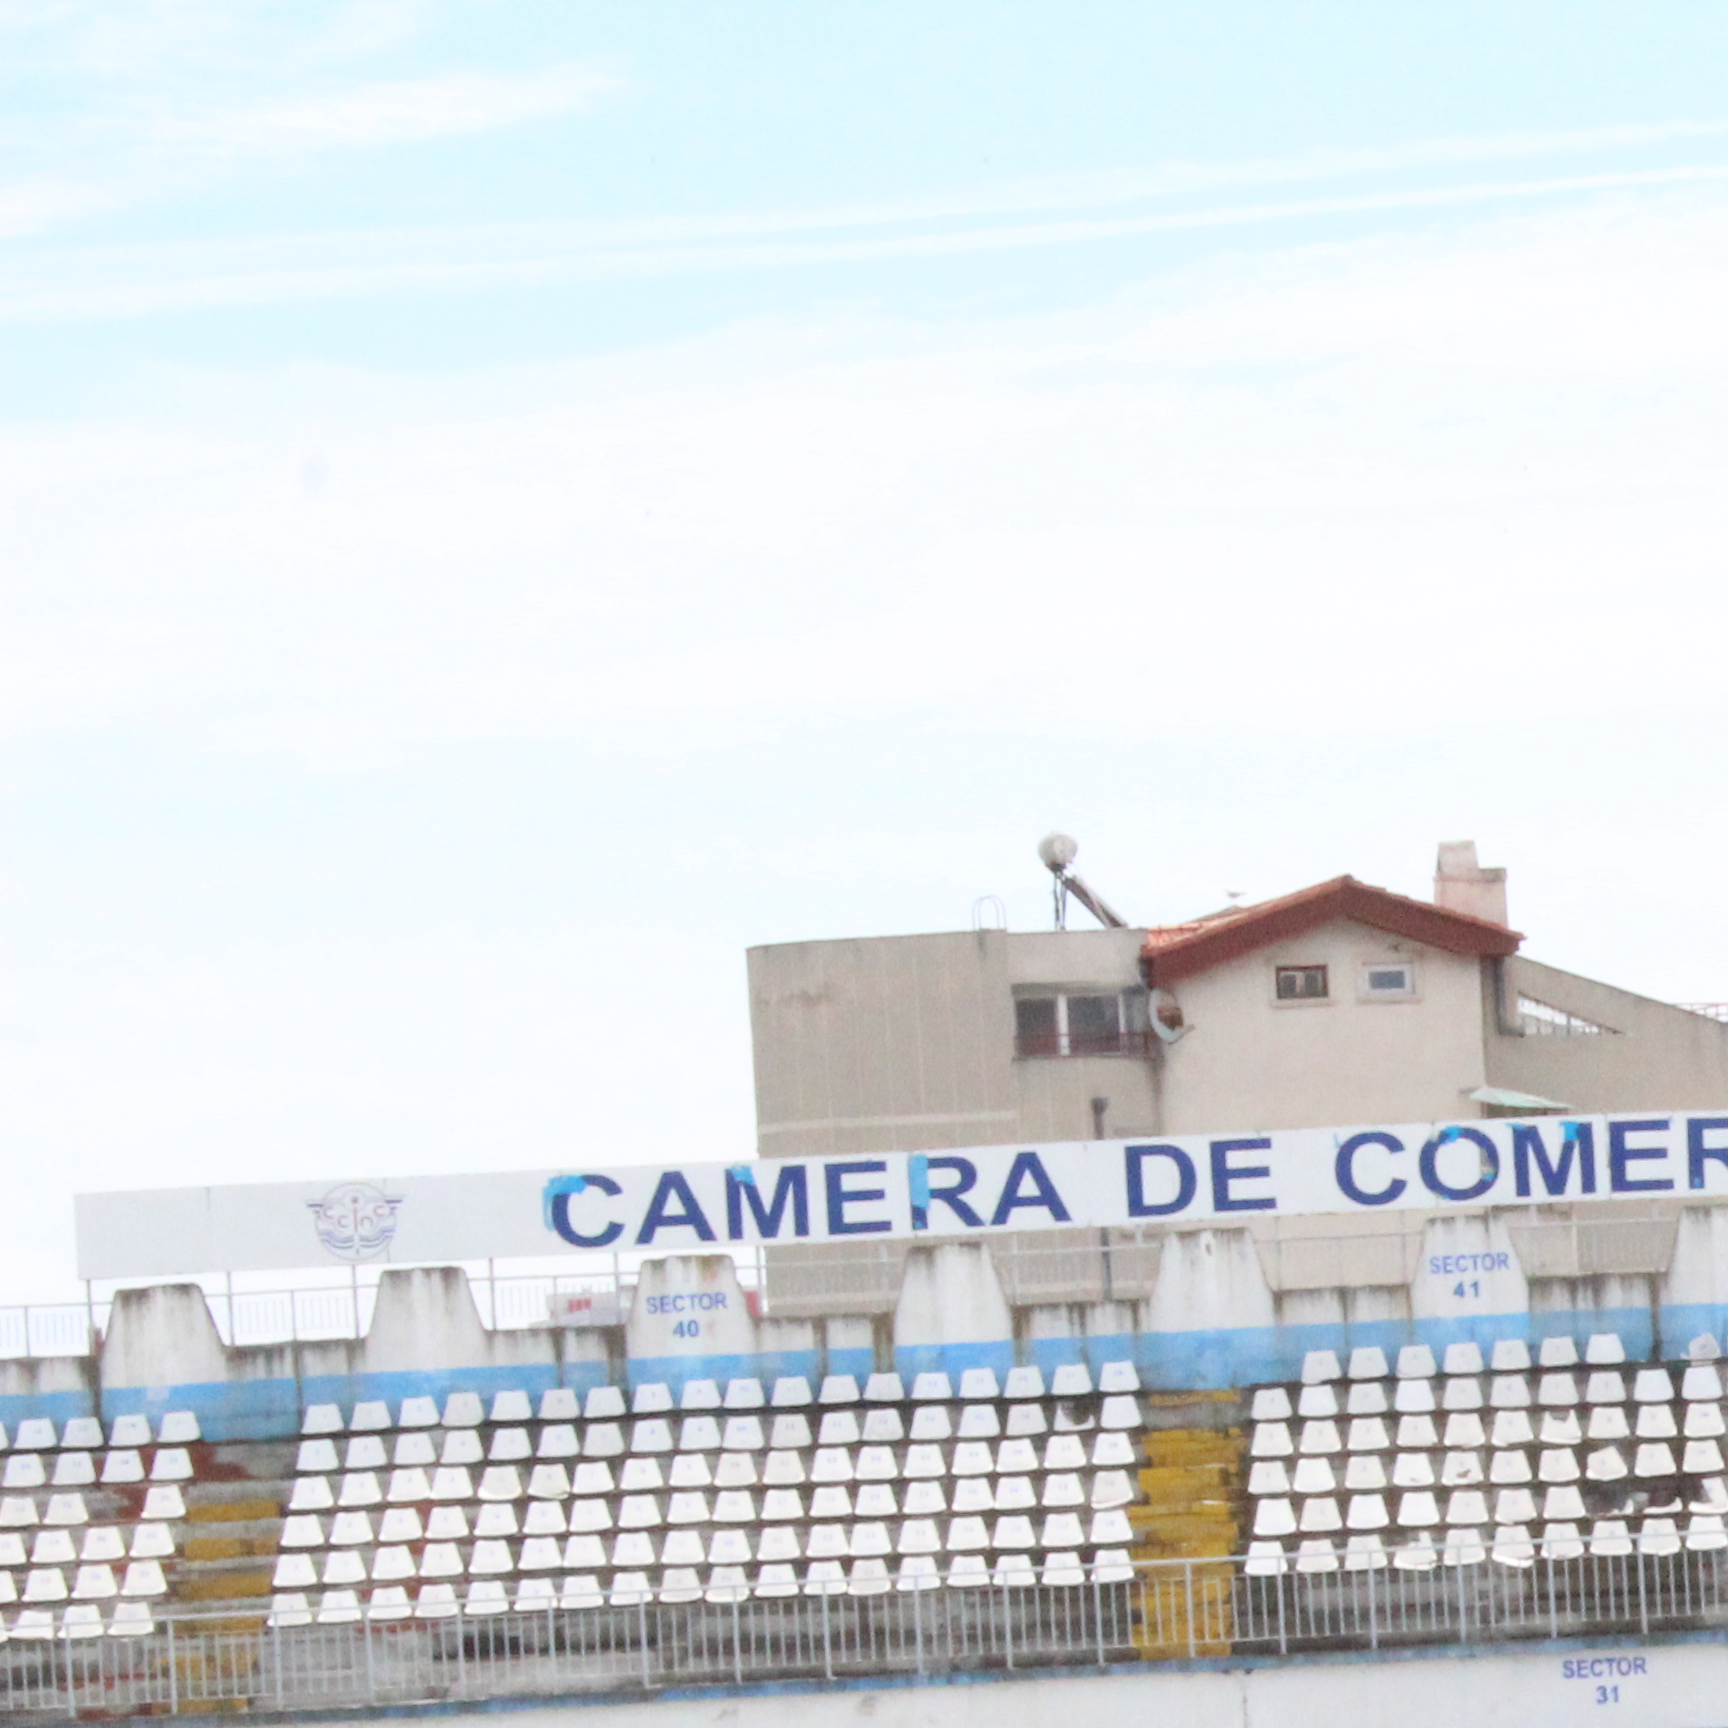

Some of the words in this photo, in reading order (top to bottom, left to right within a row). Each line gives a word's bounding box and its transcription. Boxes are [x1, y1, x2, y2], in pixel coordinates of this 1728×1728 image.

[550, 1151, 1070, 1247] CAMERA
[1126, 1138, 1275, 1218] DE
[1429, 1251, 1510, 1275] SECTOR
[1452, 1280, 1480, 1298] 41
[646, 1292, 728, 1315] SECTOR
[672, 1319, 700, 1338] 40
[1562, 1656, 1648, 1680] SECTOR
[1596, 1684, 1620, 1706] 31
